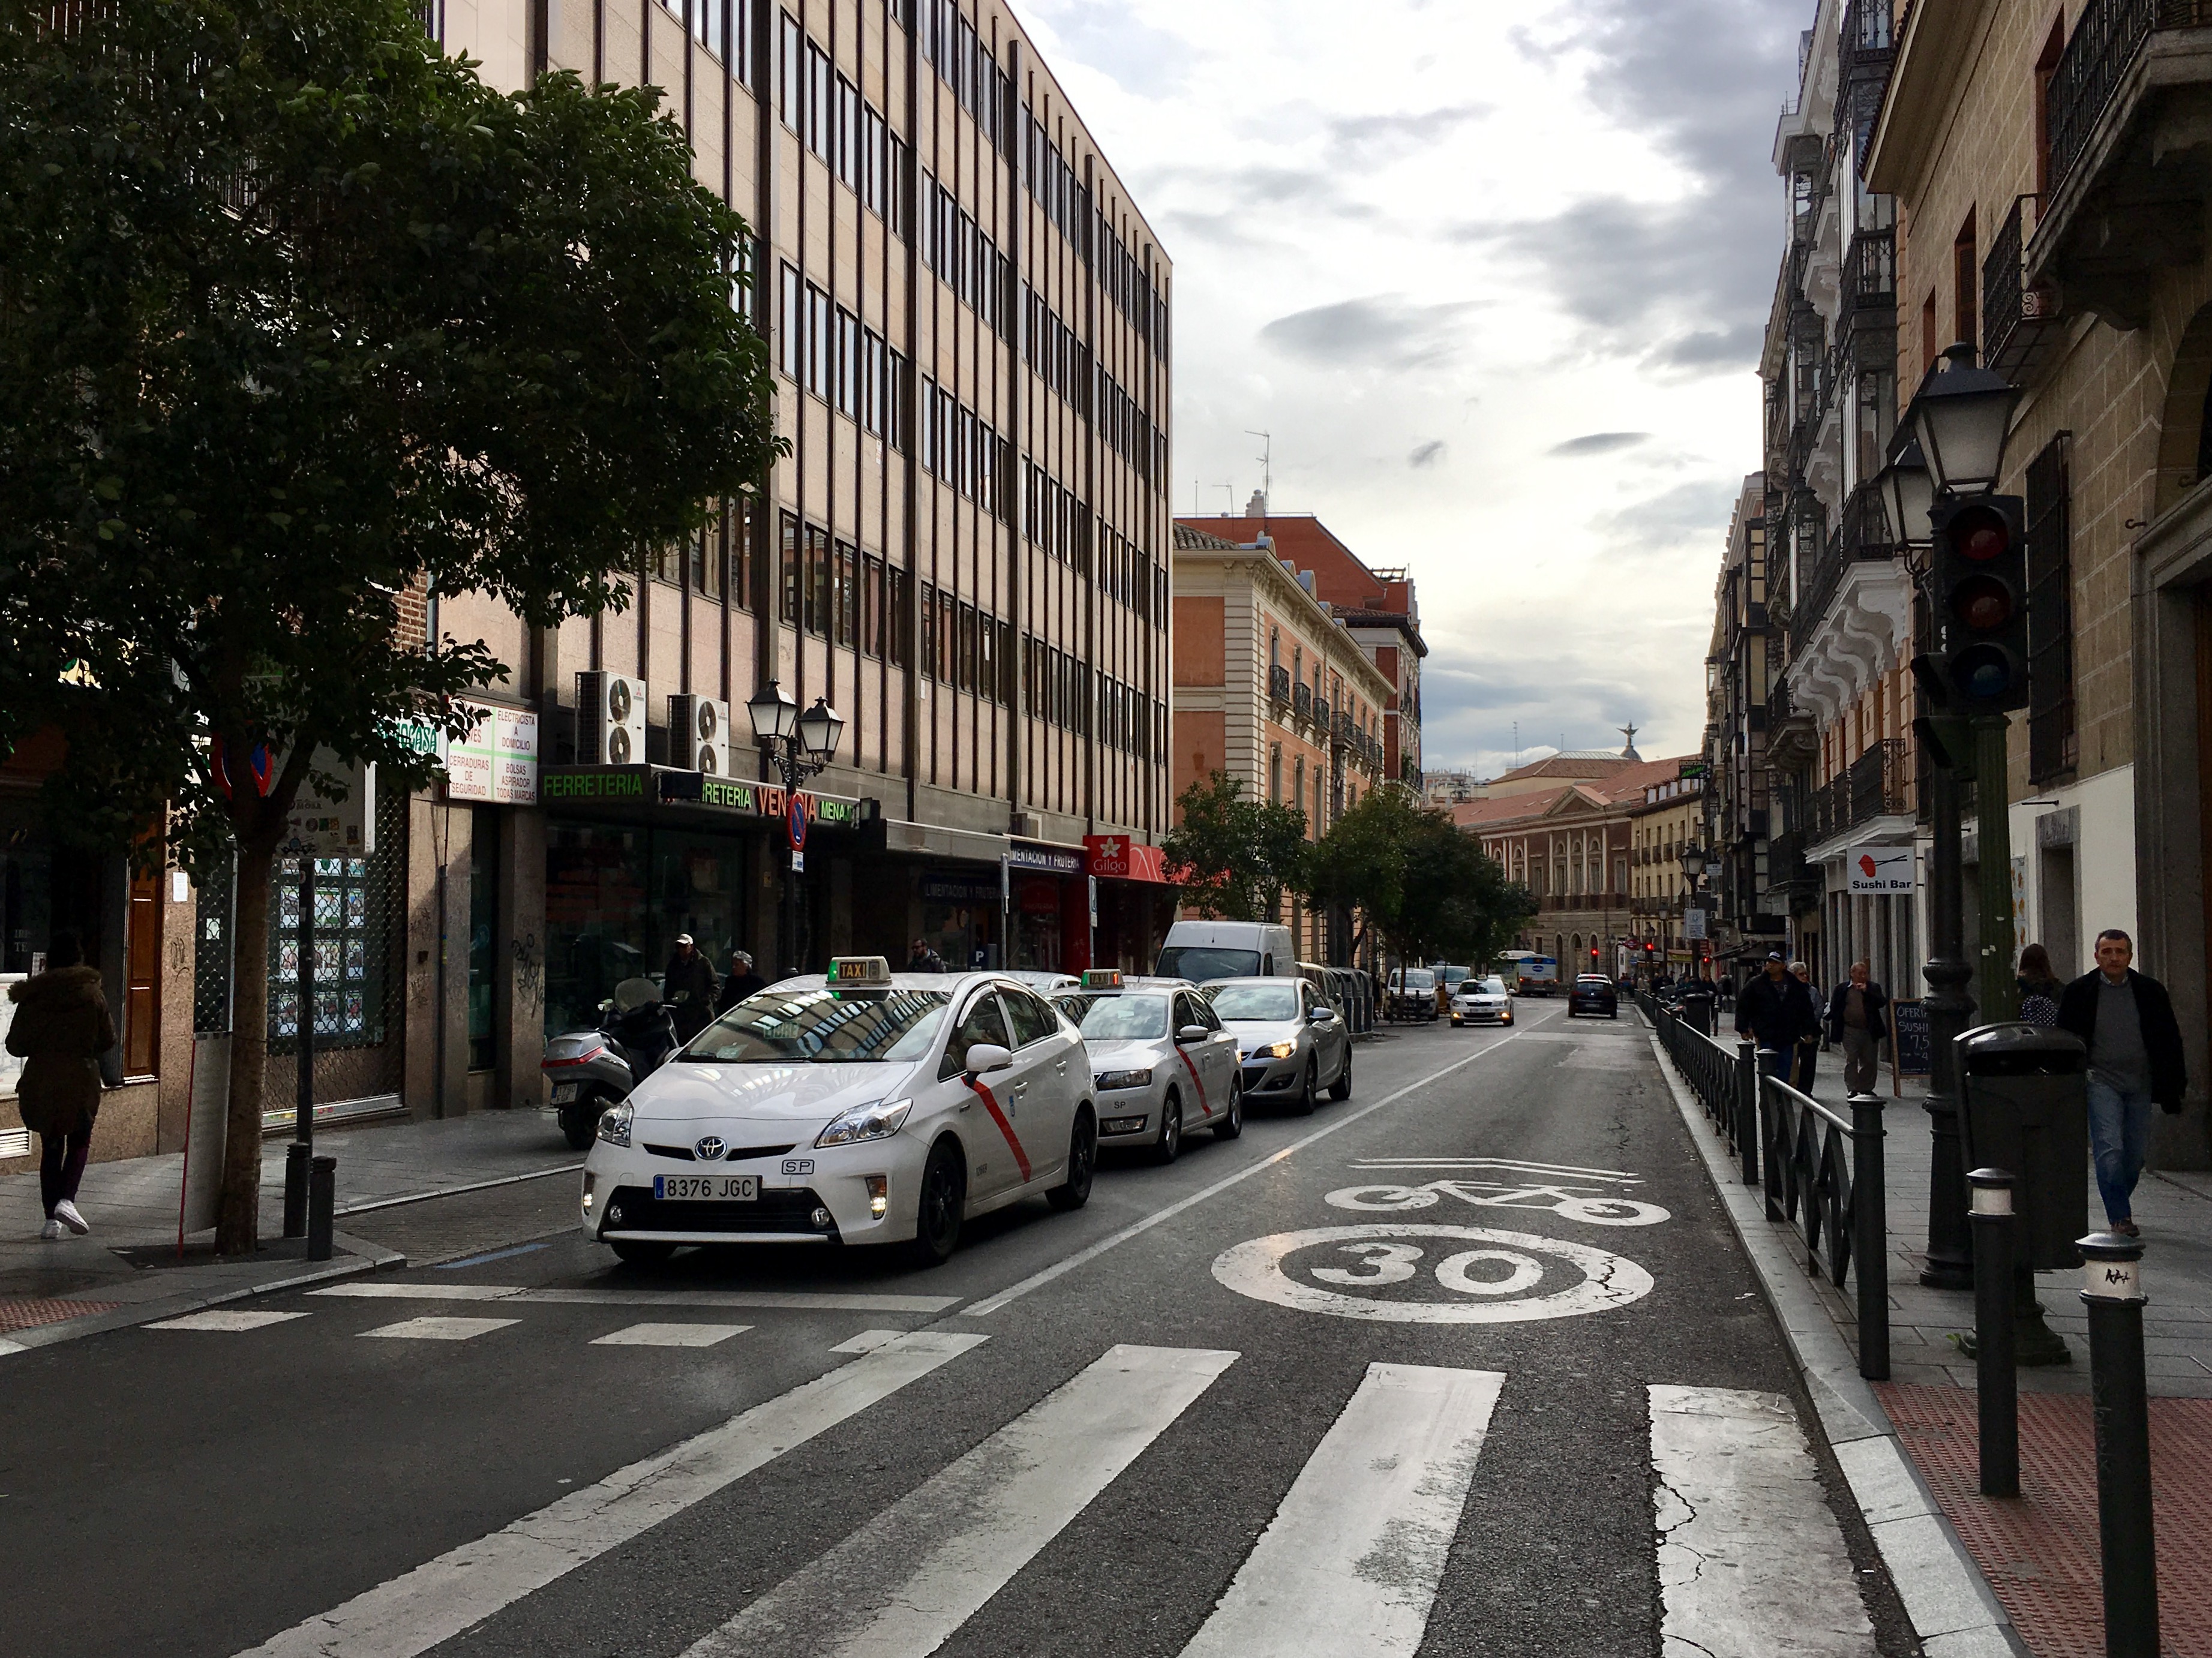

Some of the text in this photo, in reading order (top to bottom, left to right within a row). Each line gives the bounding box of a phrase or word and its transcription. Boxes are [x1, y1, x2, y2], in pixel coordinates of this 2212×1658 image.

[497, 710, 535, 726] ELECTRICISTA
[514, 726, 518, 736] A
[502, 737, 530, 750] DOMICILIO
[449, 755, 490, 770] CERRADURAS
[506, 764, 526, 775] BOLSAS
[465, 771, 473, 782] DE
[502, 776, 530, 788] ASPIRADOR
[452, 782, 487, 795] SEGURIDAD
[544, 774, 643, 797] FERRETERIA
[497, 788, 536, 801] TODAS MARCAS
[757, 786, 817, 821] VENIA
[1048, 854, 1052, 866] Y
[1054, 855, 1079, 869] FRUTERIA
[1094, 859, 1126, 873] Gilgo
[1852, 879, 1912, 889] Sushi Bar
[976, 951, 985, 962] P
[841, 963, 866, 977] TAXI
[1091, 974, 1107, 984] TAXI
[1898, 1022, 1929, 1033] SUSHI
[1114, 1101, 1126, 1109] SP
[785, 1161, 811, 1173] SP
[667, 1179, 712, 1197] 8376
[719, 1179, 752, 1197] JGC
[1310, 1242, 1544, 1295] 30
